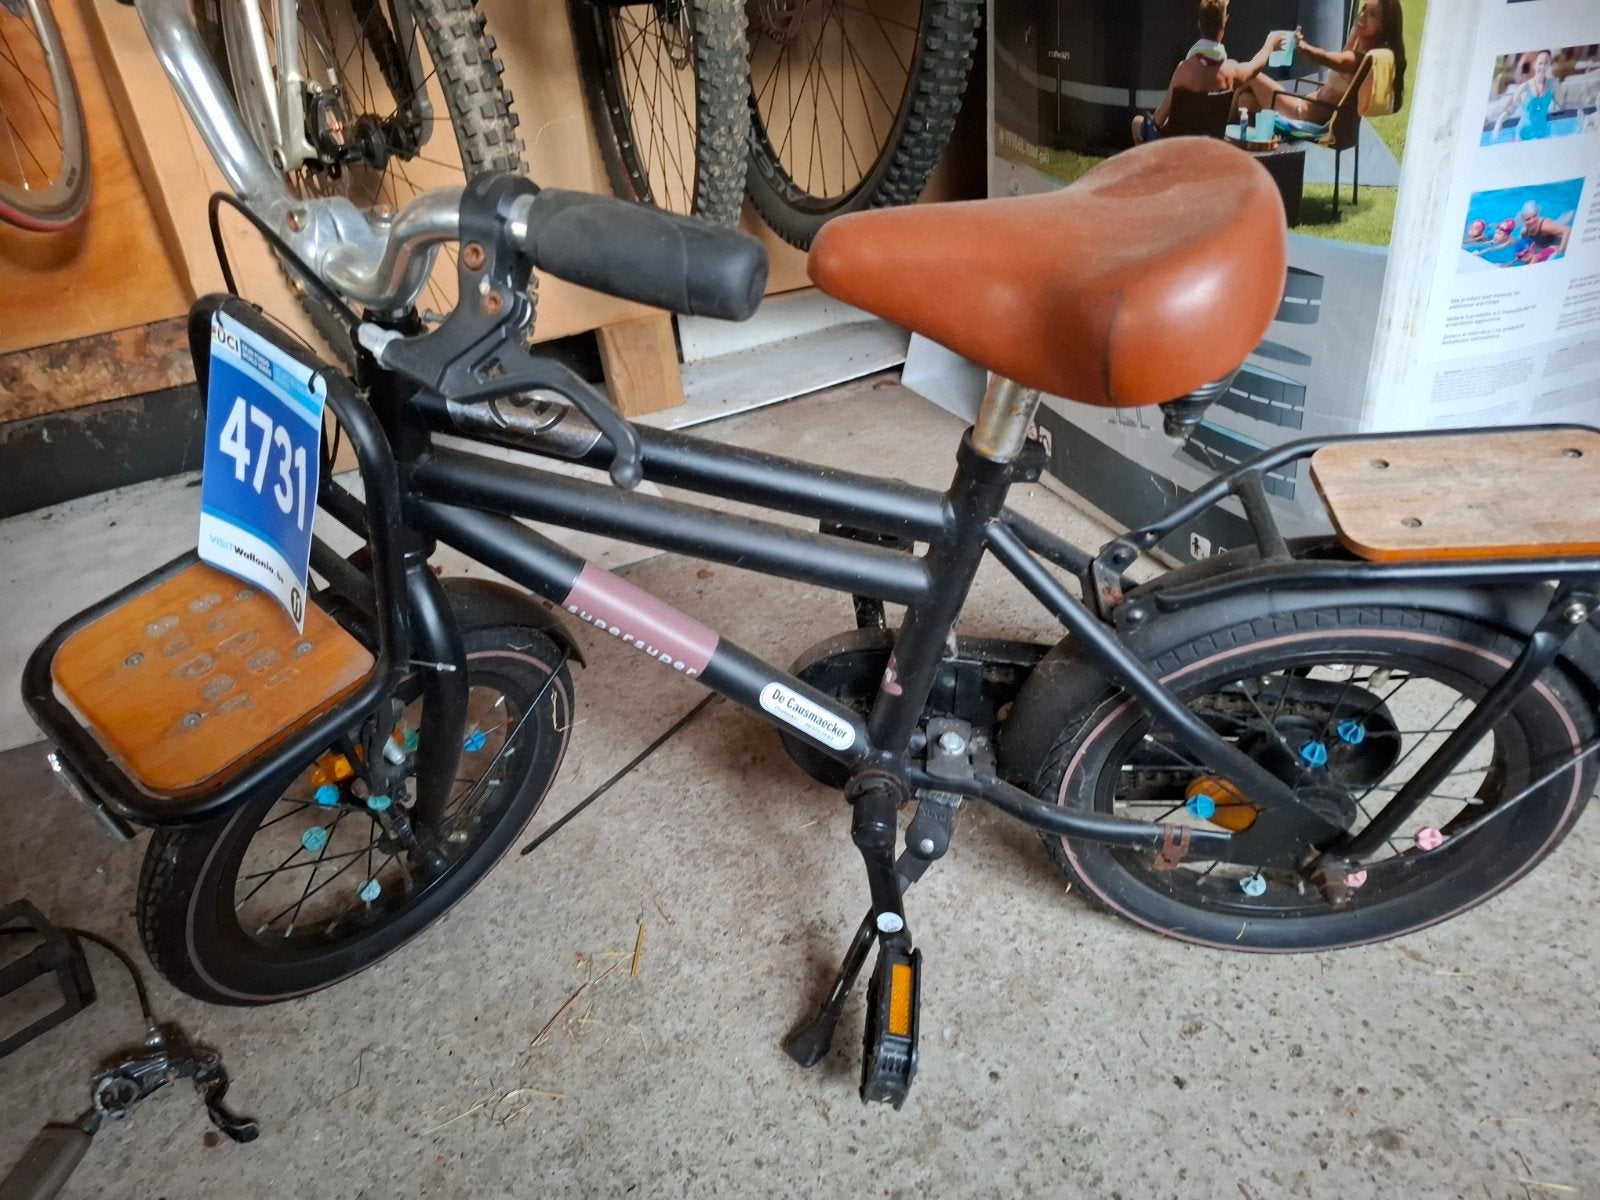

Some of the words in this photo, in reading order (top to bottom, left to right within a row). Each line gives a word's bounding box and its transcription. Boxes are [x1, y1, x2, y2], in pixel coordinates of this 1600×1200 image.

[217, 327, 239, 353] UCI
[220, 396, 307, 532] 4731
[567, 605, 697, 676] supersuper
[772, 688, 785, 704] De
[787, 697, 848, 740] Causmaecker
